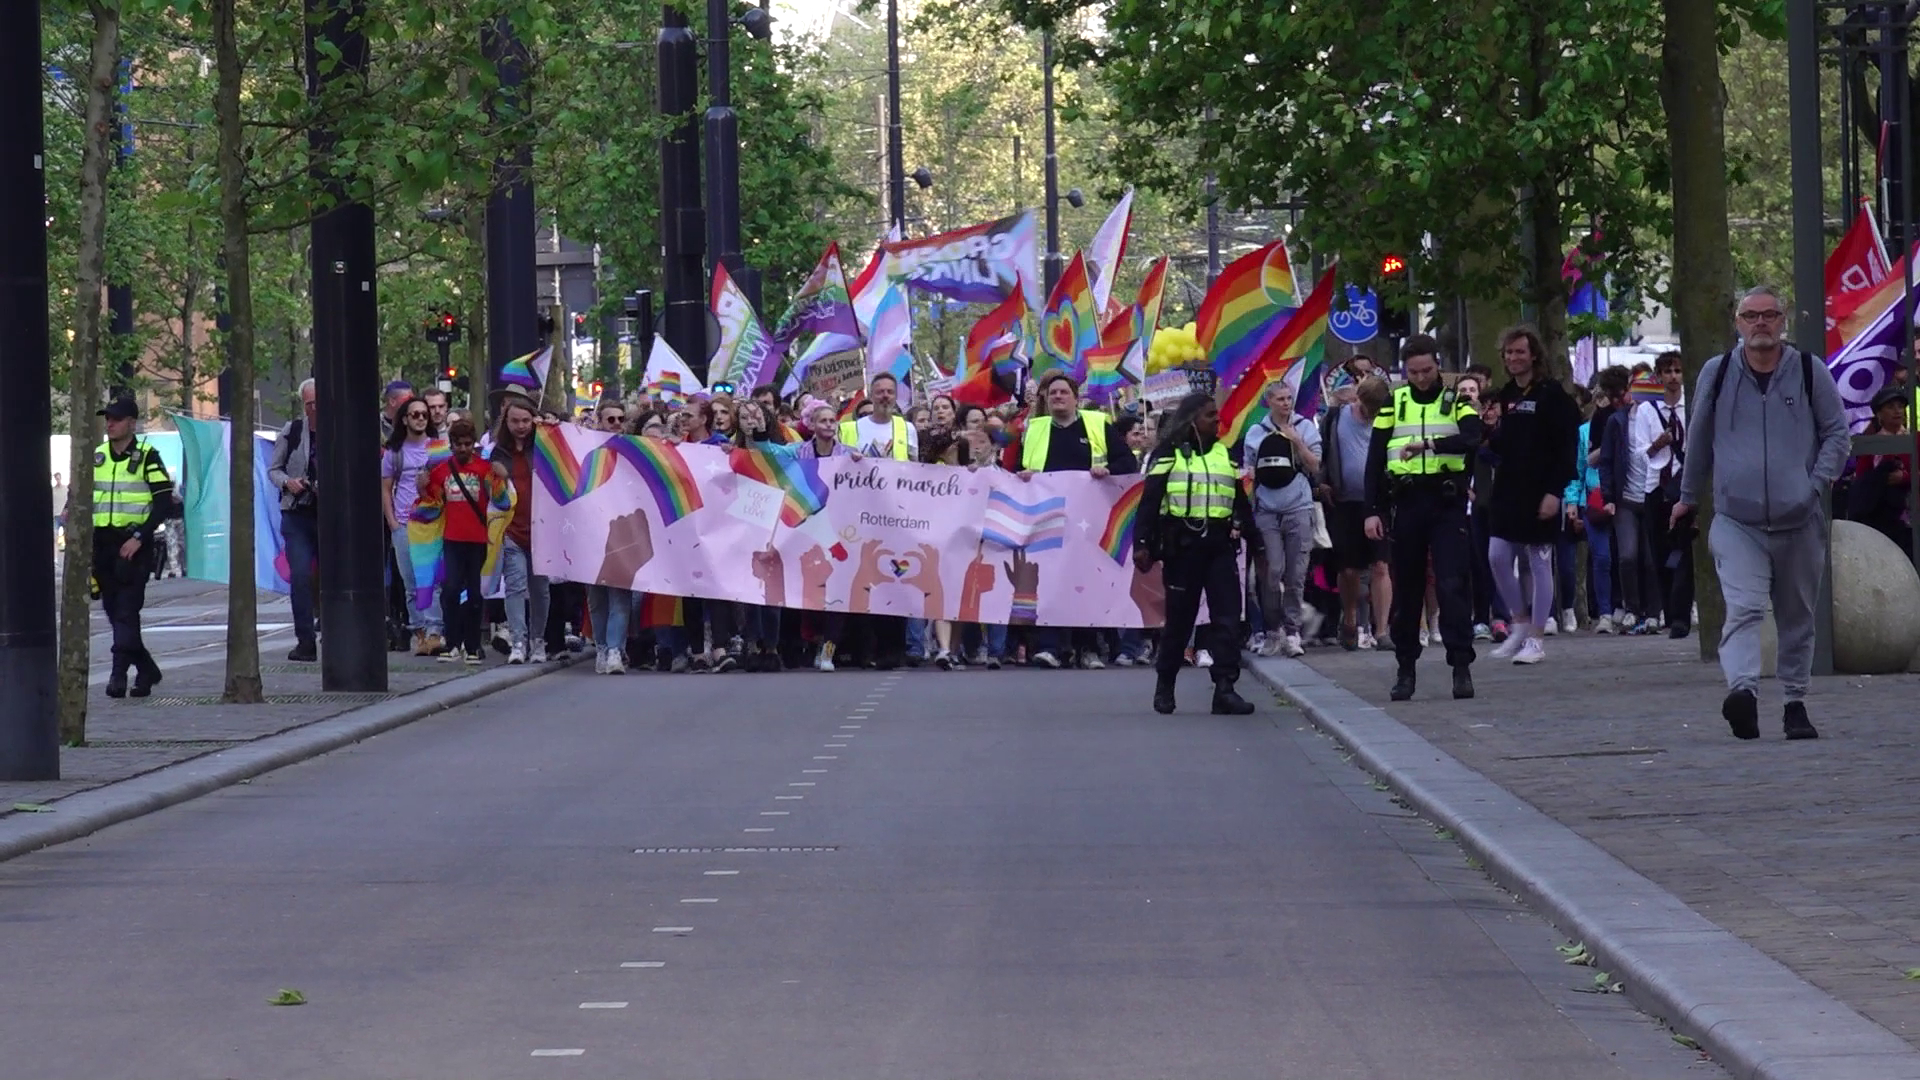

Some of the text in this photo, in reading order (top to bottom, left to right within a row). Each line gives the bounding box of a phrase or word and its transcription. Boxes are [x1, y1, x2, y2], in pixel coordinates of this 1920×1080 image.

[834, 466, 963, 497] pride march
[747, 488, 771, 504] LOVE
[743, 504, 766, 520] LOVE
[860, 512, 930, 530] Rotterdam
